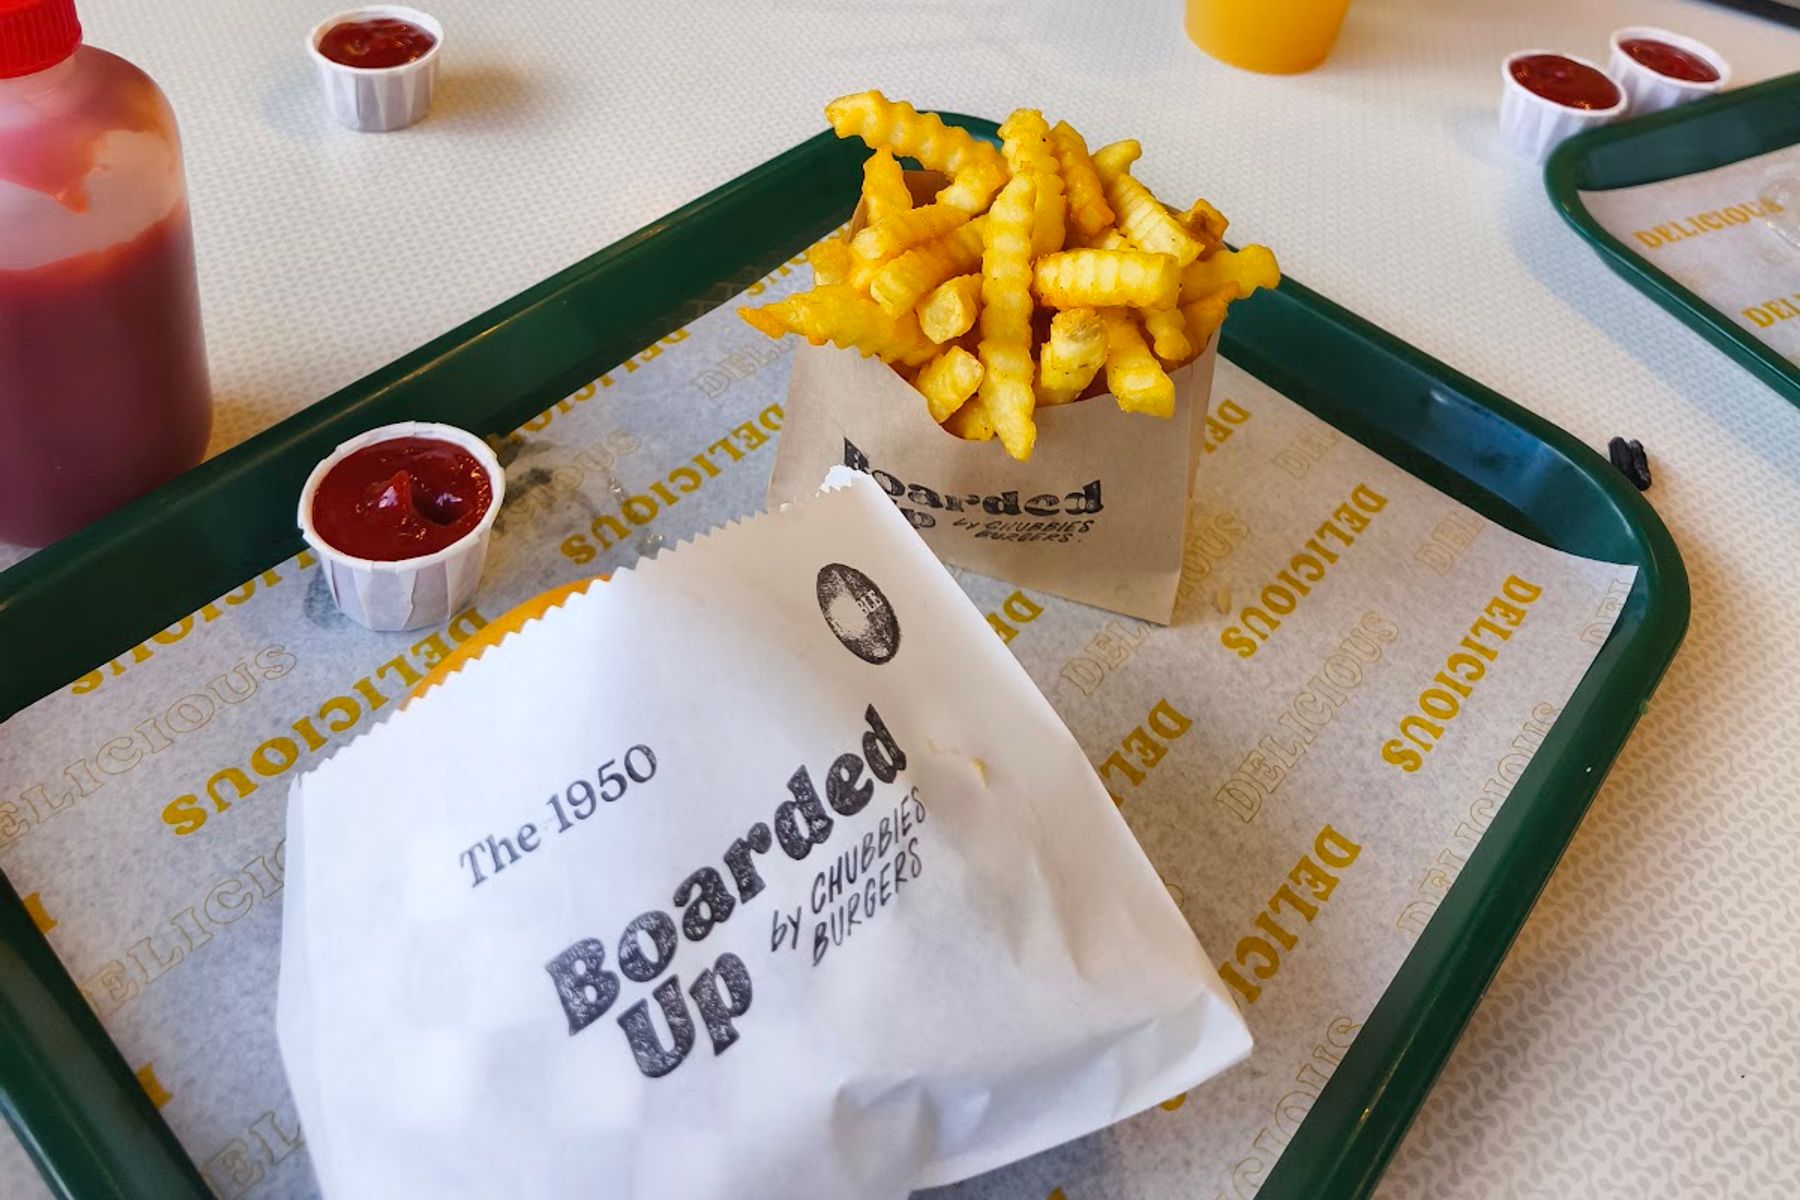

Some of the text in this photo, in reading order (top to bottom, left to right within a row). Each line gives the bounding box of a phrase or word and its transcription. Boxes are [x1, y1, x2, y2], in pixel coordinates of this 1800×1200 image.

[1634, 196, 1786, 248] DELICIOUS
[560, 402, 784, 565] DELICIOUS
[843, 436, 1104, 517] Boarded
[1220, 483, 1388, 659] DELICIOUS
[162, 607, 490, 836] DELICIOUS
[1215, 611, 1399, 823] DELICIOUS
[1381, 574, 1543, 773] DELICIOUS
[459, 744, 657, 888] The 1950
[545, 704, 907, 1035] Boarded
[771, 786, 927, 952] by CHUBBIES
[811, 838, 923, 968] BURGERS
[617, 952, 754, 1078] Up
